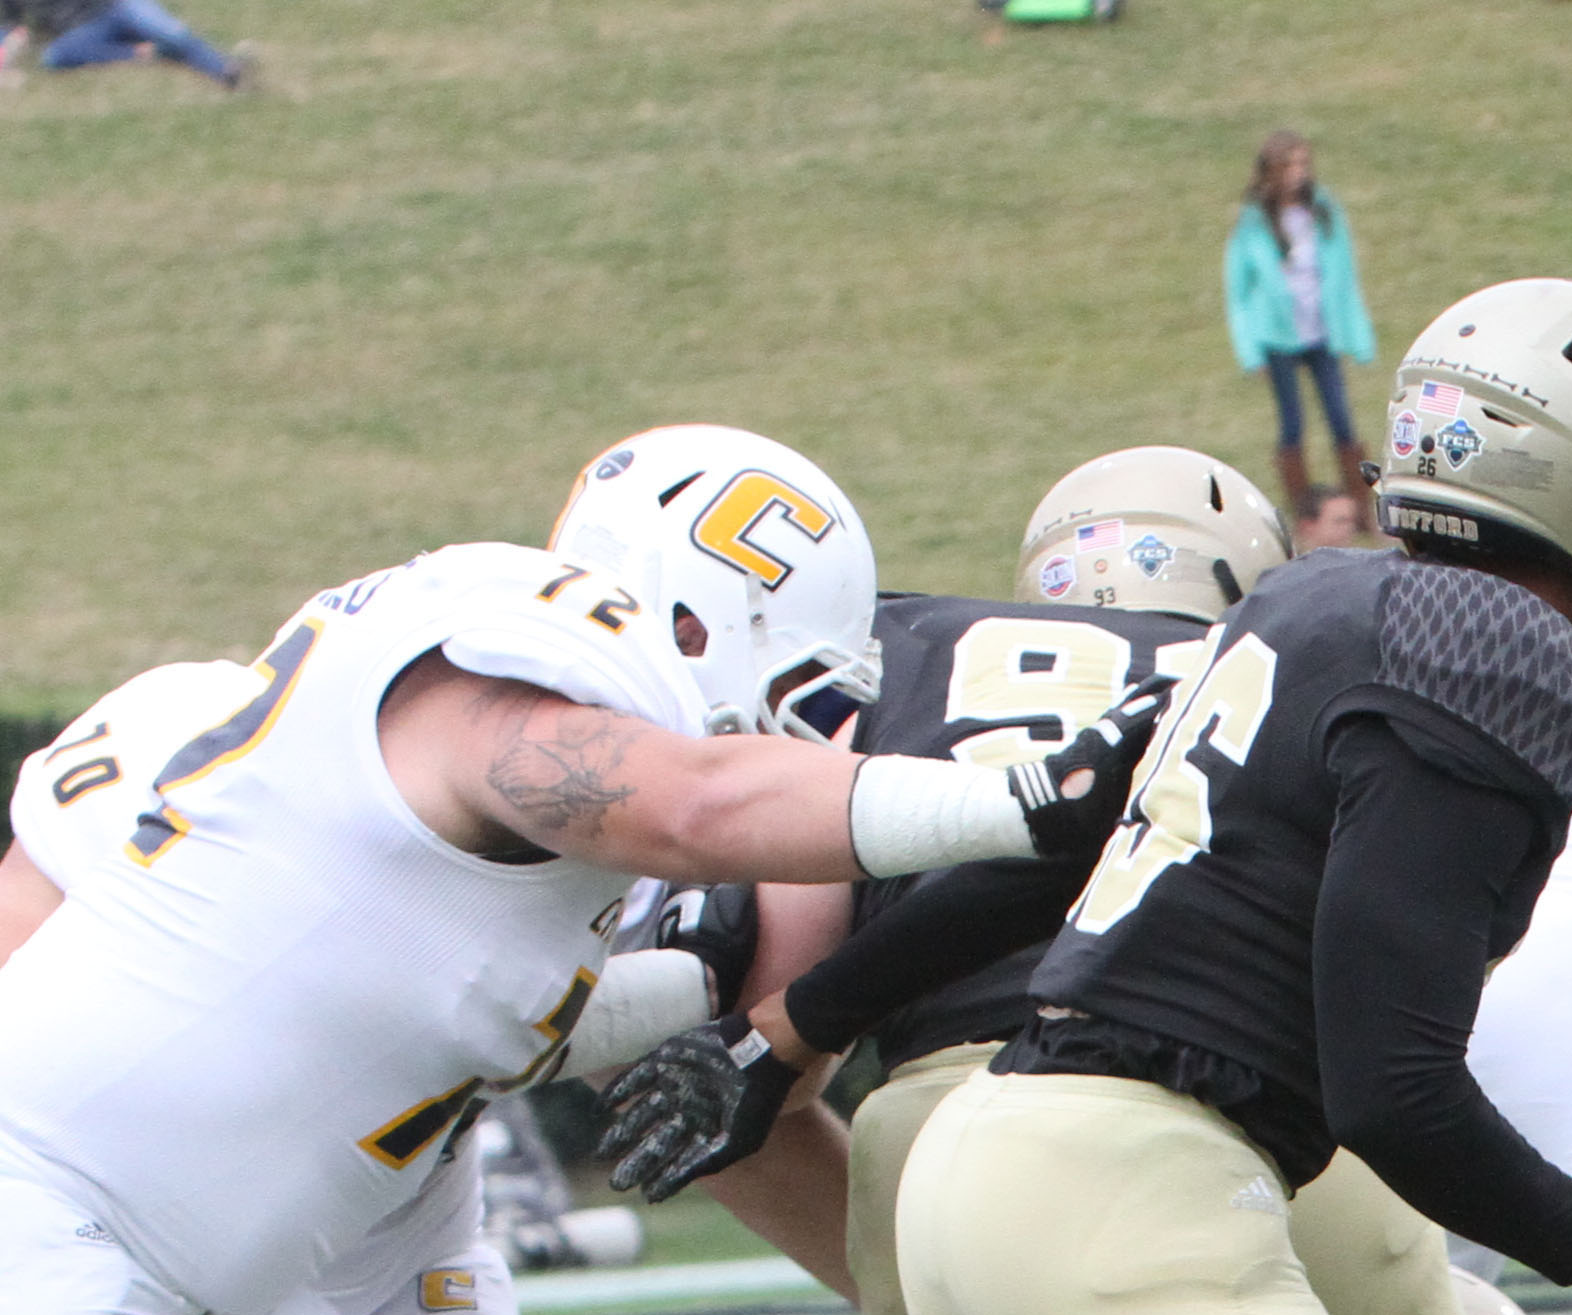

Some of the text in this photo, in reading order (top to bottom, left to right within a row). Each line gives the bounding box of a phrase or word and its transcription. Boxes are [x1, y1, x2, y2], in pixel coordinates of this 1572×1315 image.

[1441, 432, 1477, 449] FCS
[1417, 456, 1436, 477] 26
[690, 468, 836, 593] C
[537, 563, 642, 636] 72
[1093, 586, 1116, 607] 93
